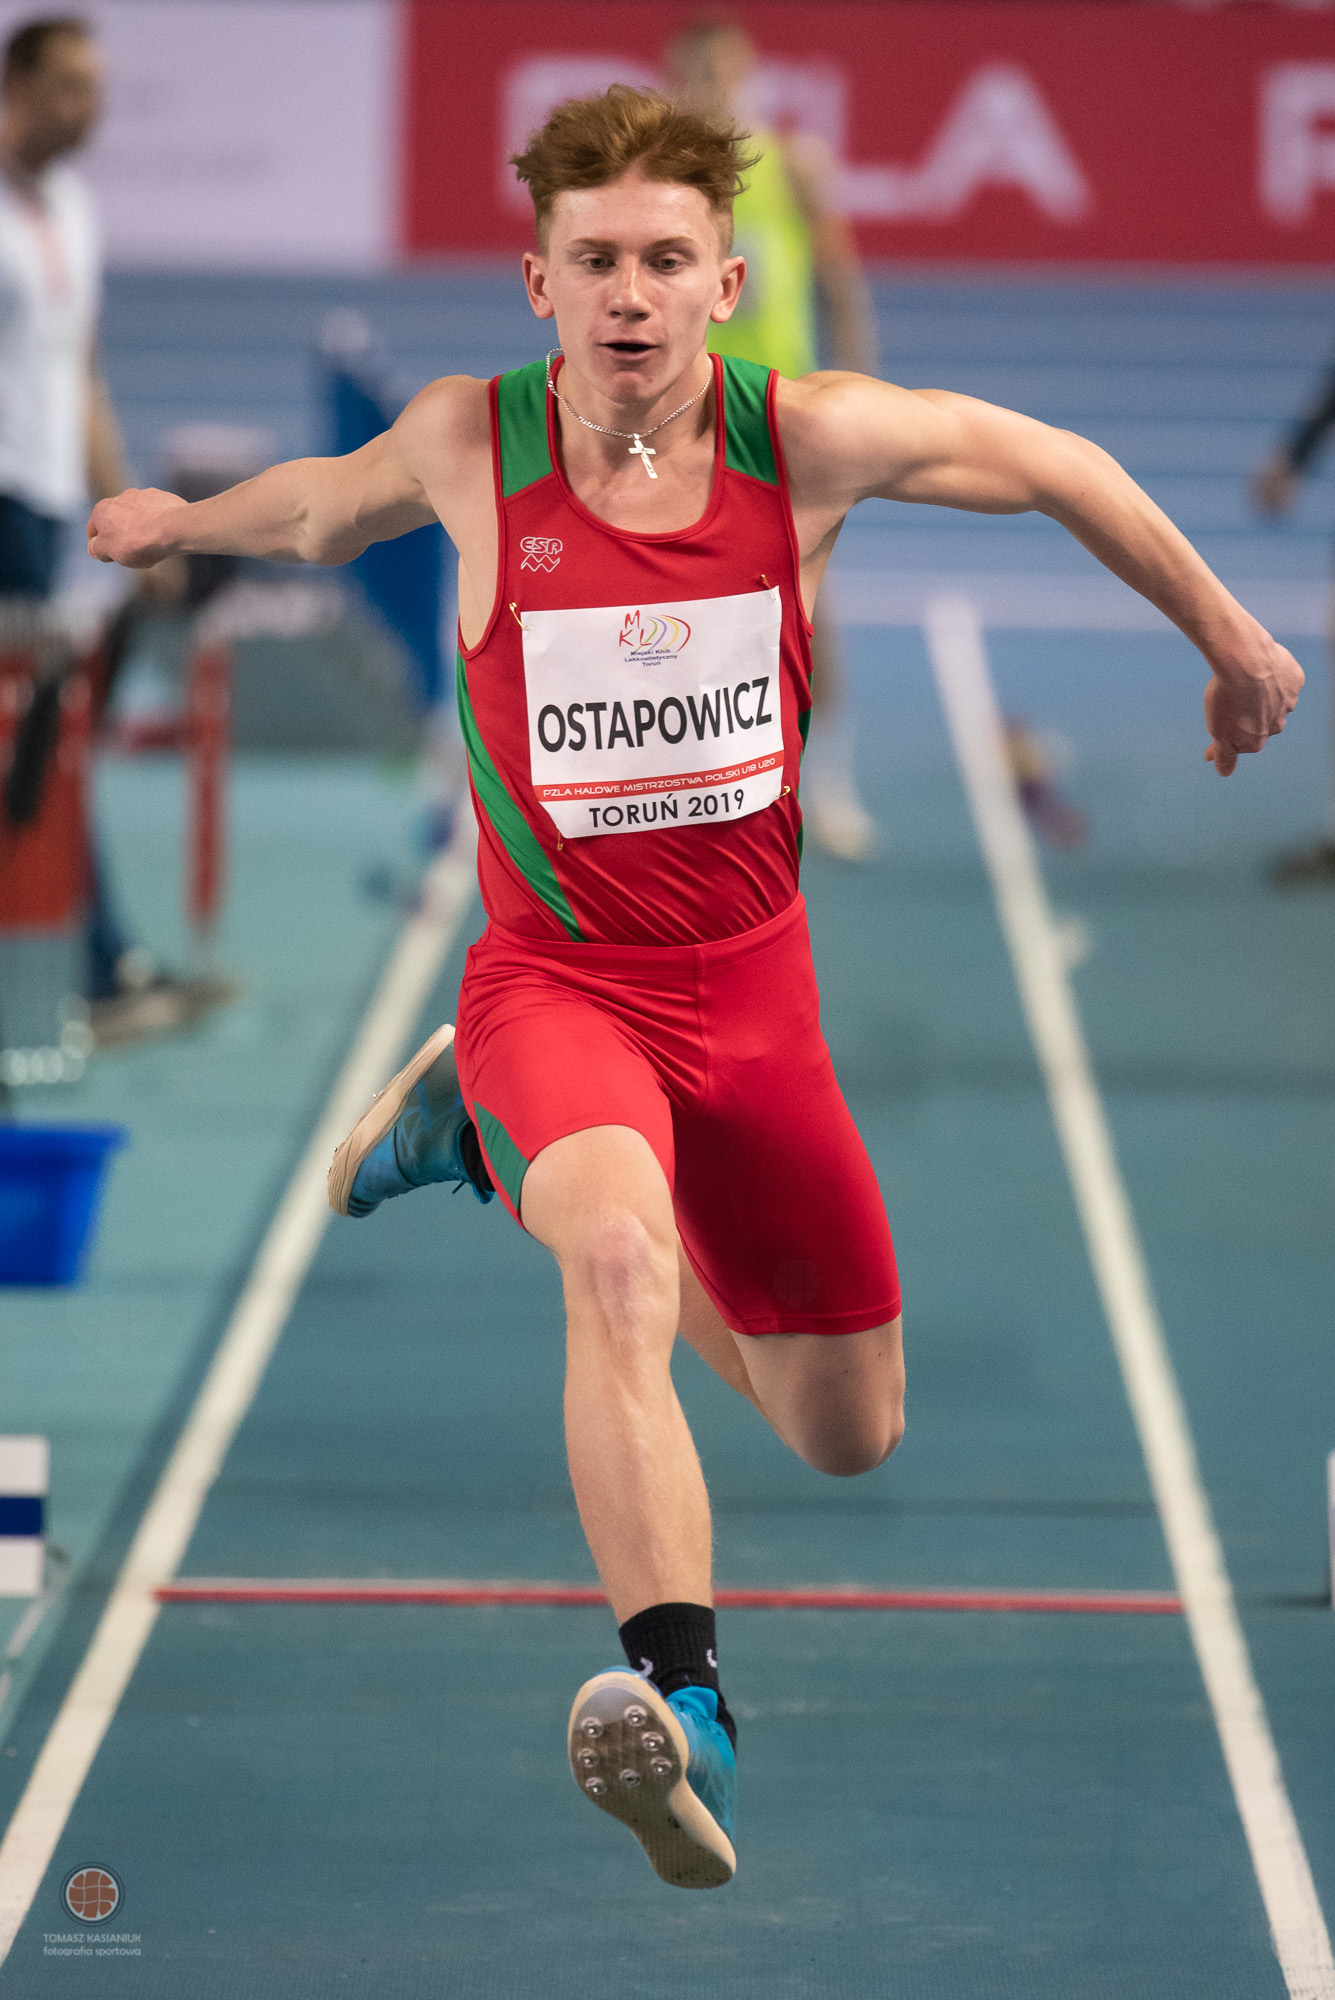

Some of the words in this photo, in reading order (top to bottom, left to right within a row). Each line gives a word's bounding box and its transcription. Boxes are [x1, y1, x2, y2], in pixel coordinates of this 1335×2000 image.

[624, 609, 640, 630] M
[537, 676, 772, 753] OSTAPOWICZ
[543, 788, 572, 797] PZLA
[574, 785, 620, 796] HALOWE
[623, 776, 703, 793] MISTRZOSTWA
[705, 768, 740, 783] POLSKI
[741, 763, 757, 775] U18
[758, 757, 776, 769] U20
[588, 792, 678, 828] TORUŃ
[688, 788, 744, 817] 2019
